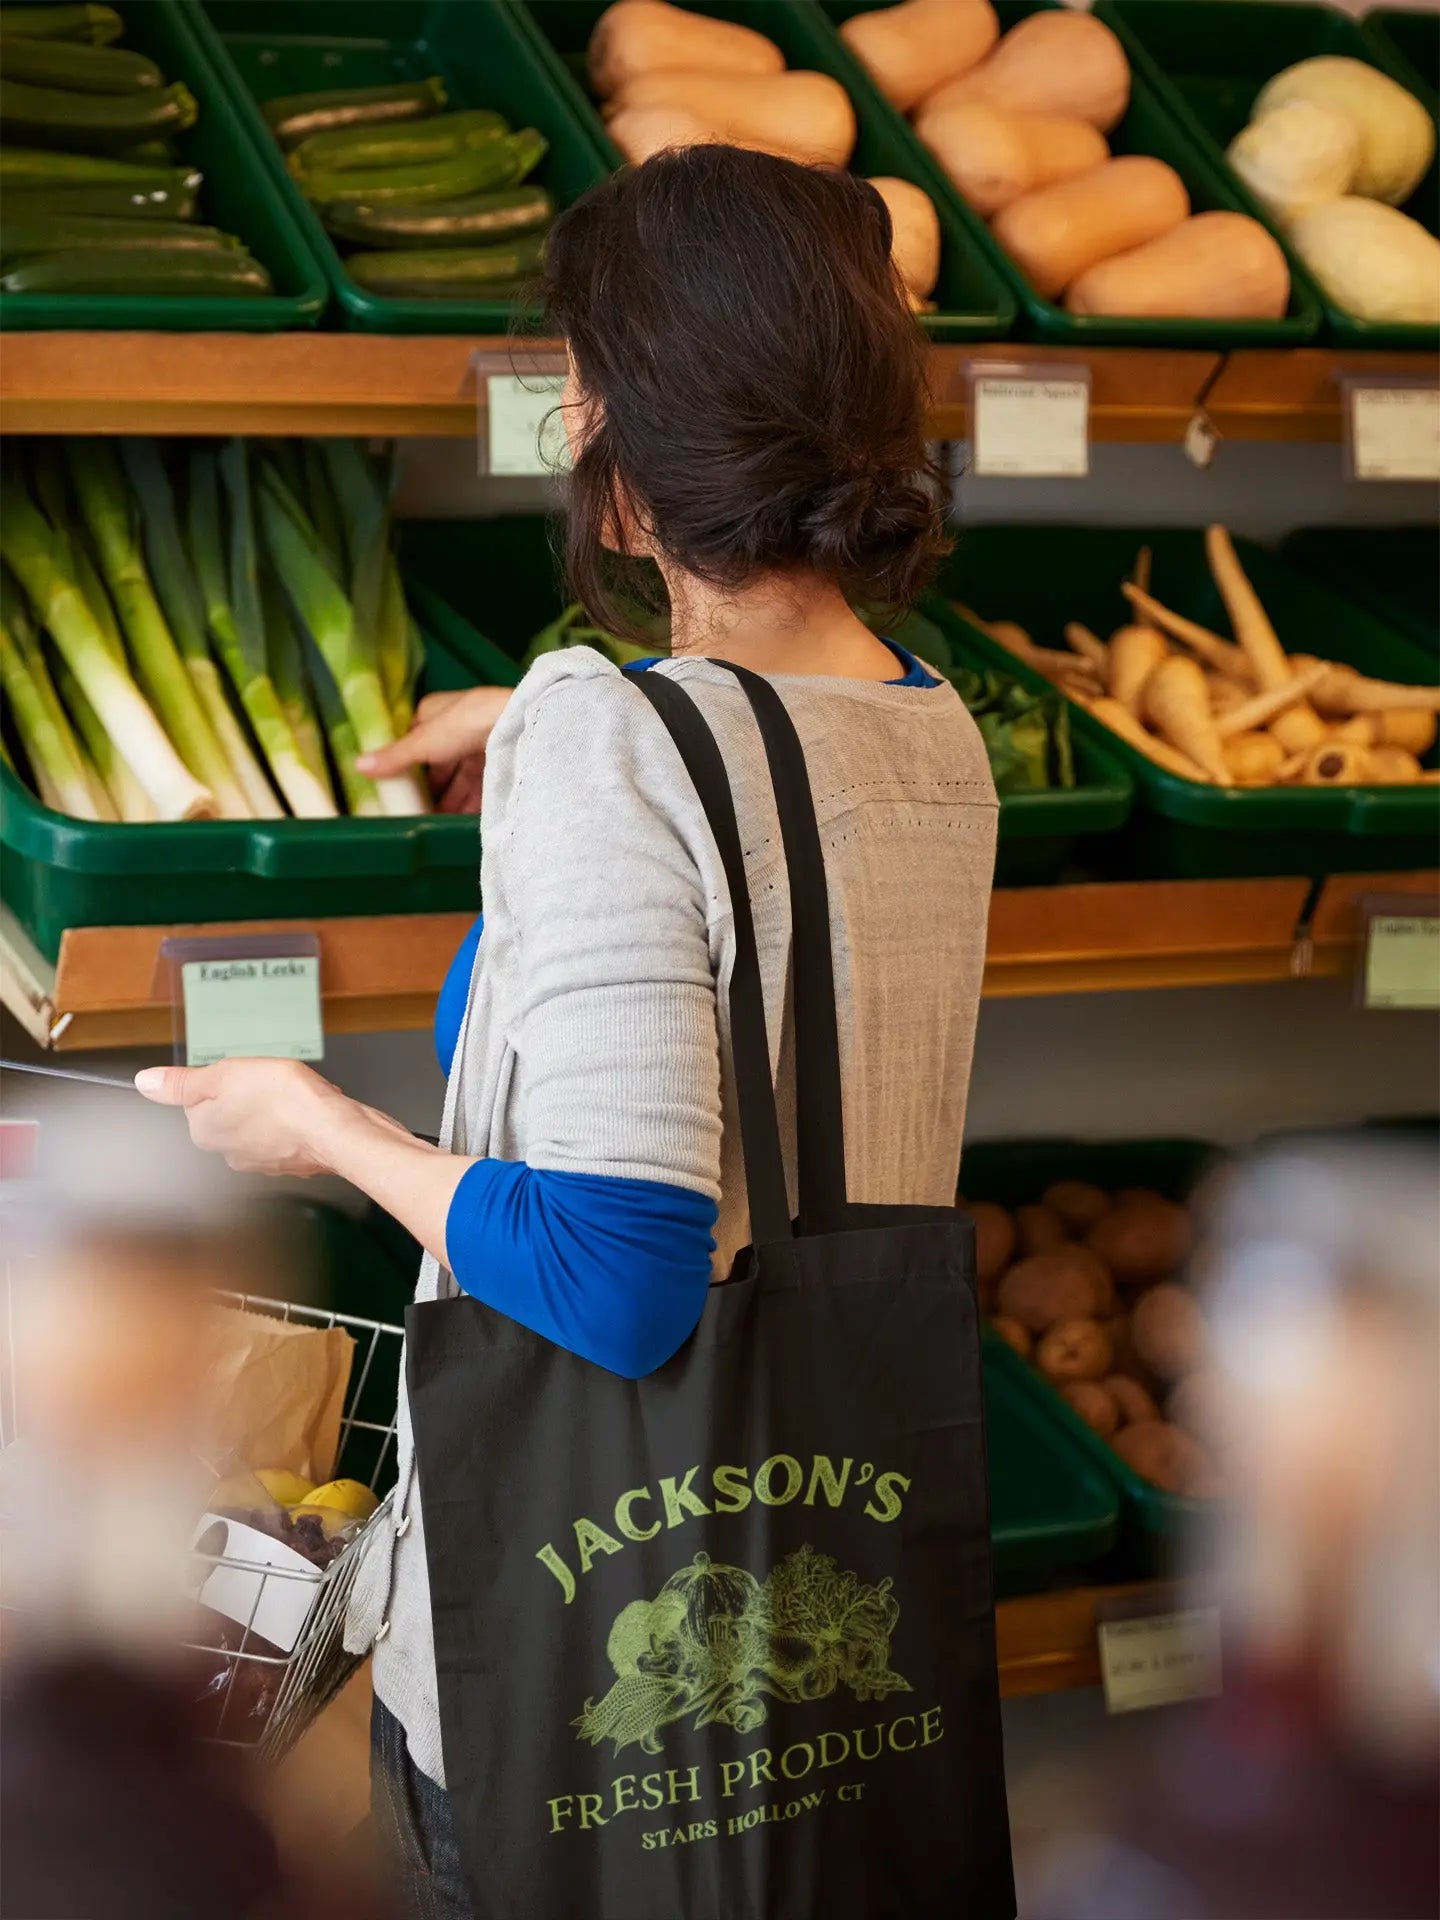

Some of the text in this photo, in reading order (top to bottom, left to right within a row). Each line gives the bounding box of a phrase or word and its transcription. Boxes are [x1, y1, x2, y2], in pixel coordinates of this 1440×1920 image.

[535, 1454, 912, 1604] JACKSON'S
[546, 1706, 945, 1833] FRESH PRODUCE
[641, 1819, 718, 1850] STARS
[837, 1783, 866, 1802] CT
